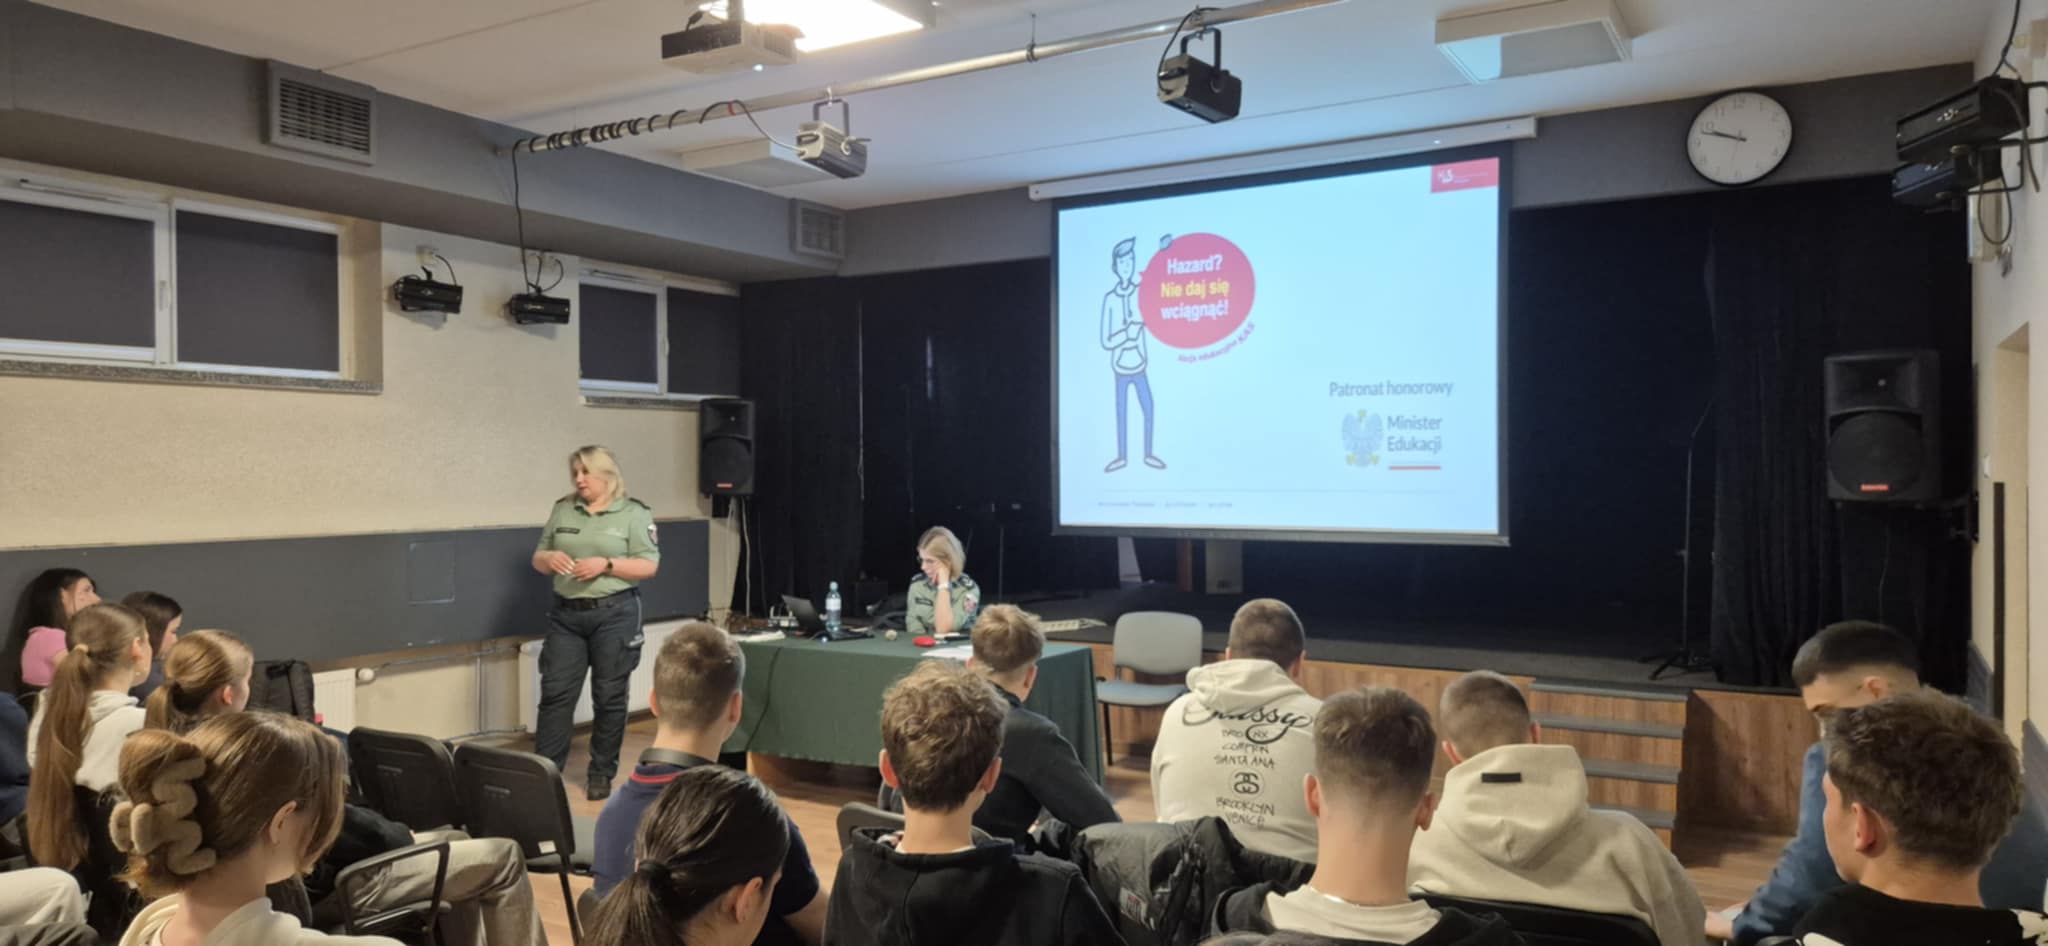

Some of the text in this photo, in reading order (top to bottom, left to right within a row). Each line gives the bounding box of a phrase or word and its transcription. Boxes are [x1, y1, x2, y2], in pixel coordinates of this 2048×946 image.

[1167, 253, 1223, 275] Hazard?
[1161, 278, 1230, 300] Nie daj się
[1160, 299, 1228, 322] wciągnąć!
[1329, 379, 1454, 398] Patronat honorowy
[1387, 414, 1442, 430] Minister
[1387, 435, 1442, 455] Edukacji
[1213, 755, 1276, 770] SANTA ANA
[1216, 797, 1275, 817] BROOKLYN
[1224, 812, 1266, 830] VENICE
